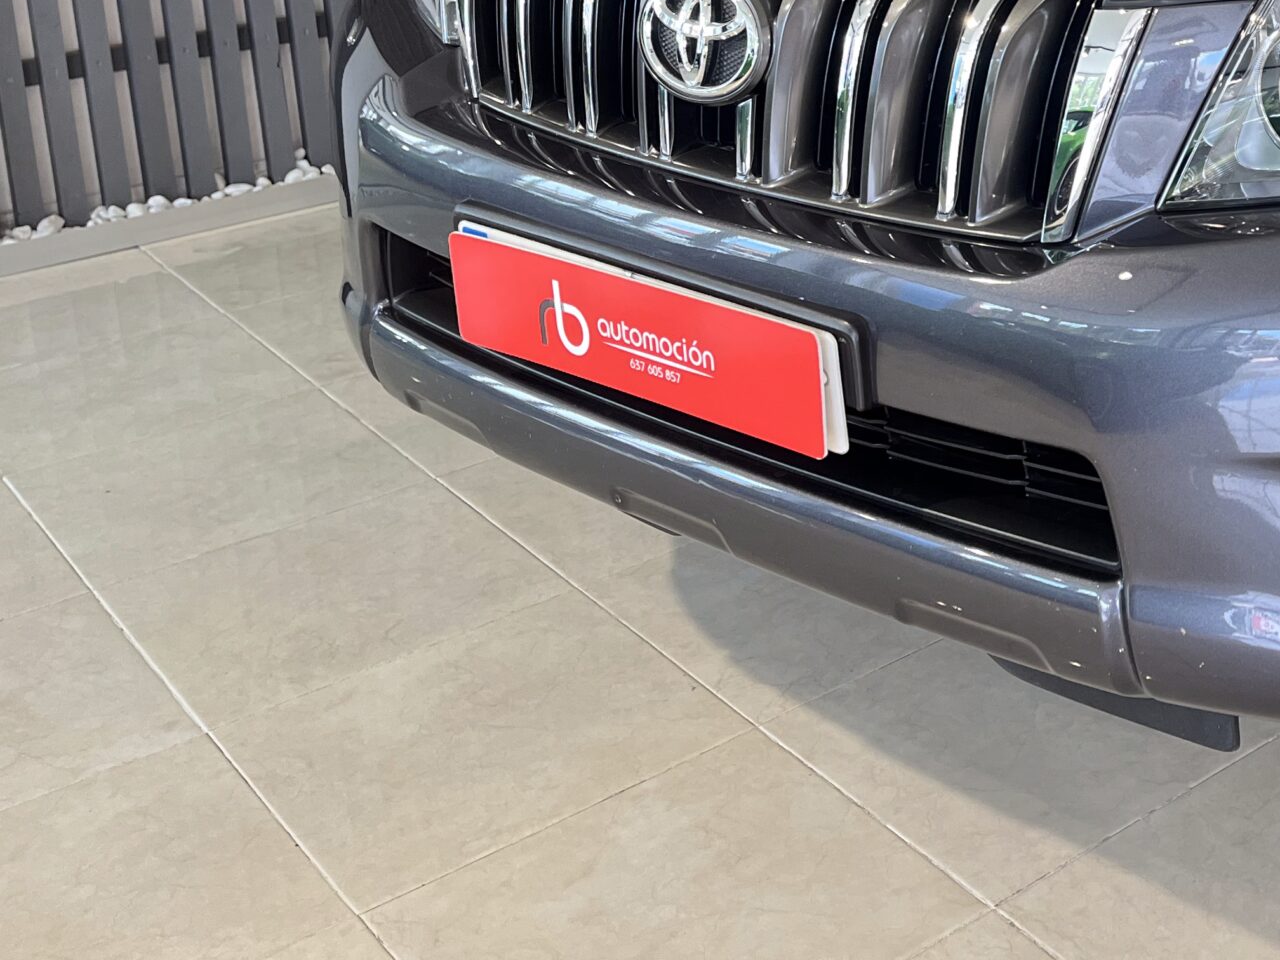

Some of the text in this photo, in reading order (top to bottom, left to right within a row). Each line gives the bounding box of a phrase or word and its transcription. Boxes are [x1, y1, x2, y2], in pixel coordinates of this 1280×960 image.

[597, 317, 716, 372] automoción
[629, 358, 681, 384] 637 605 857
